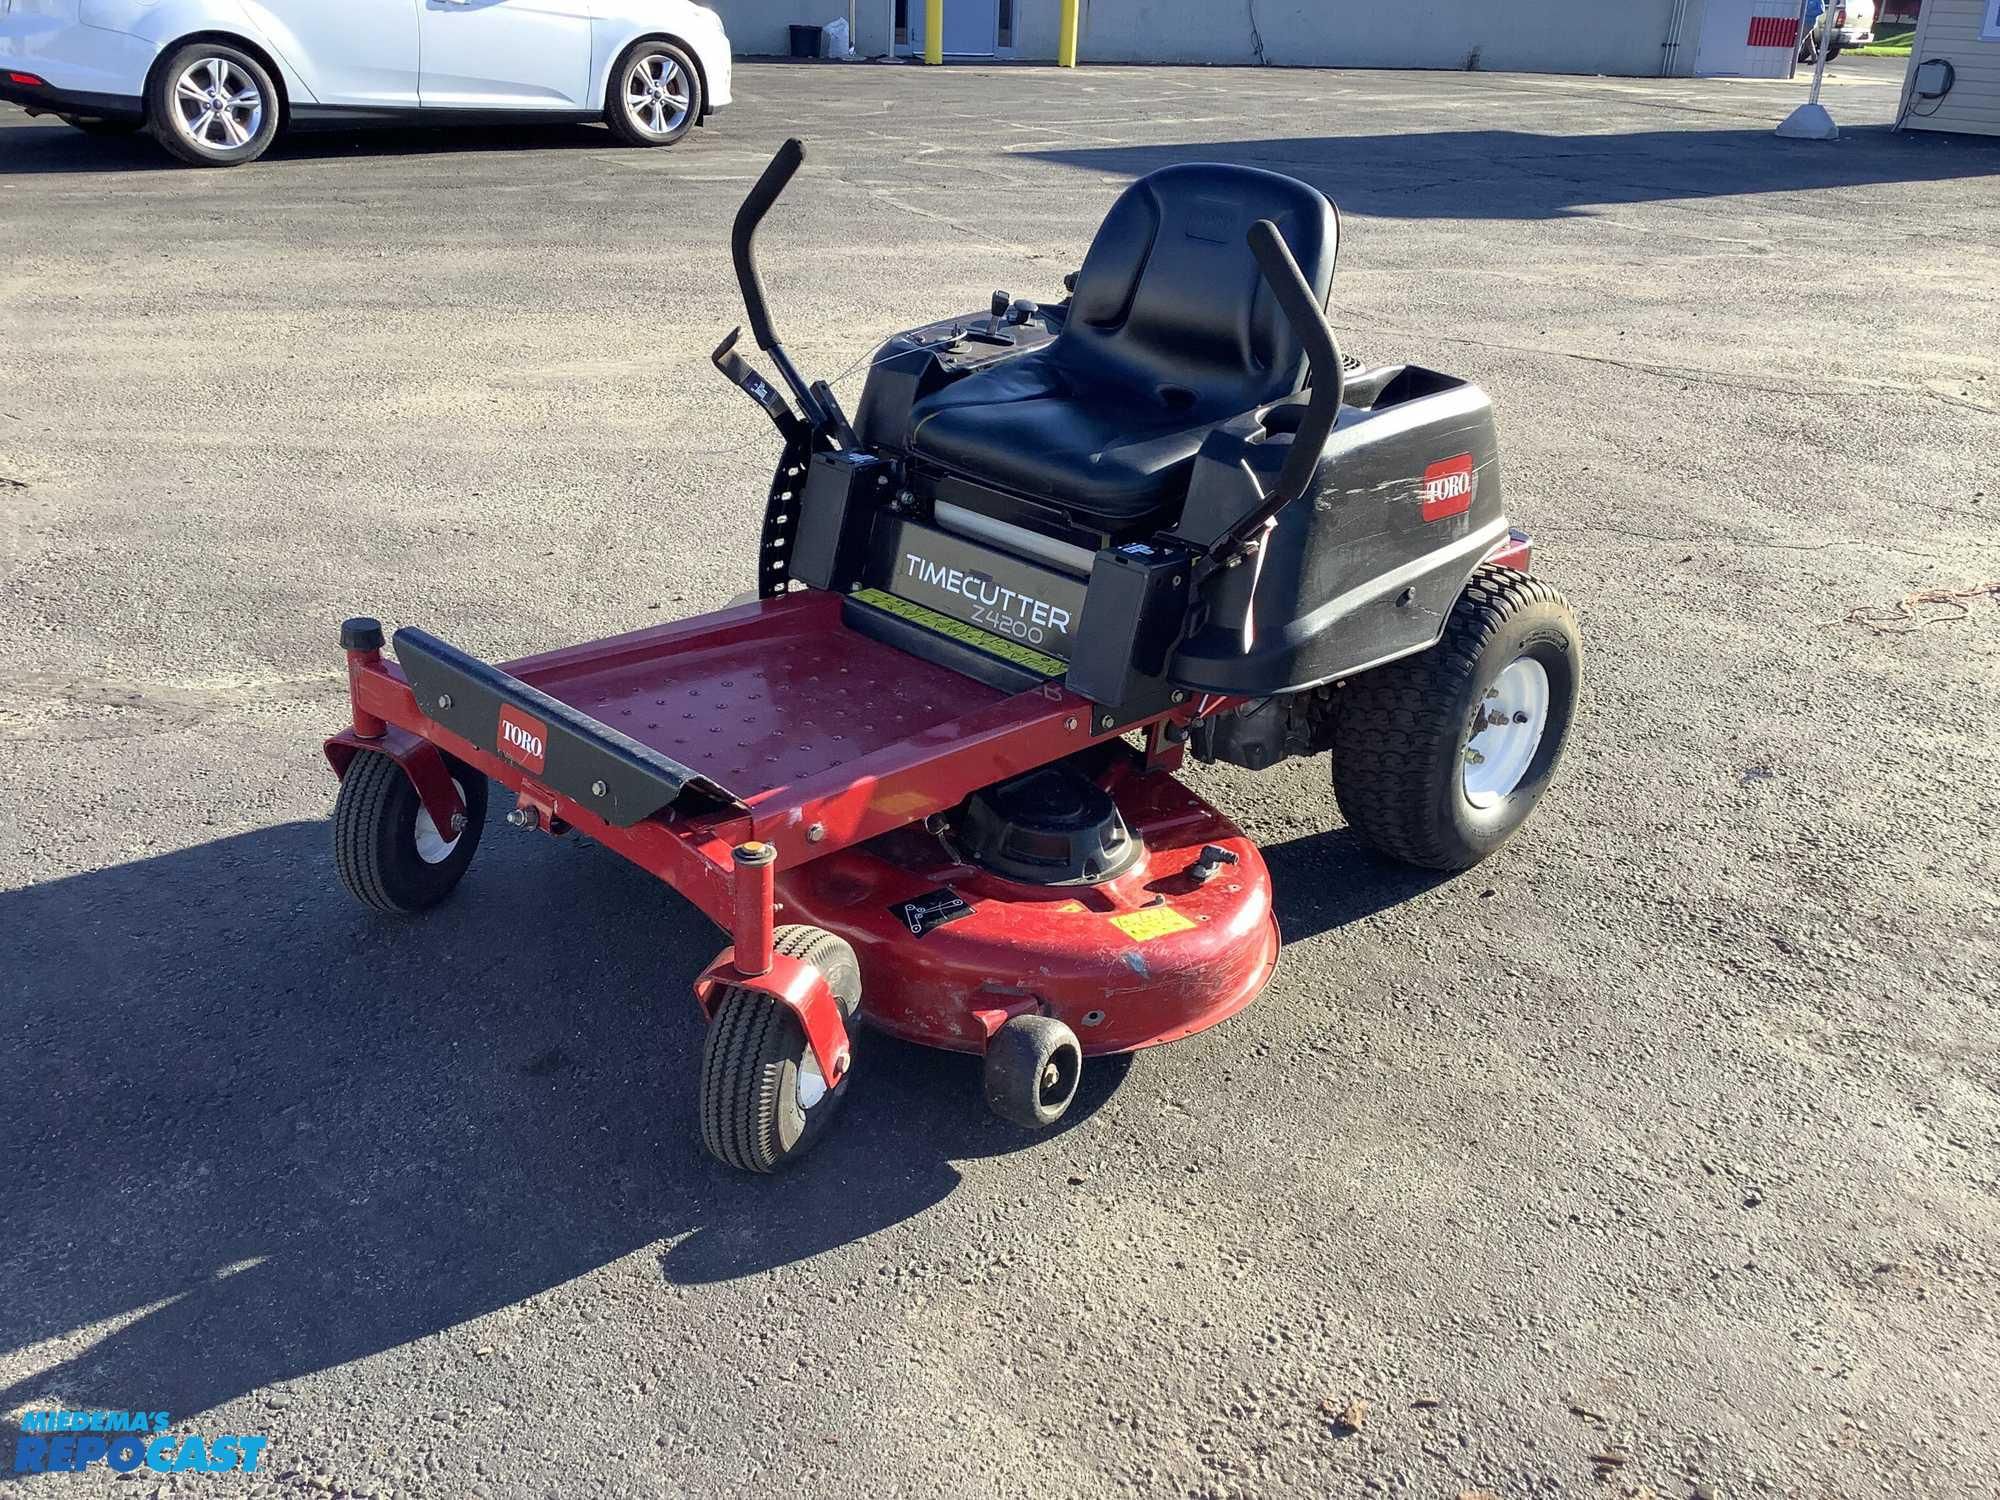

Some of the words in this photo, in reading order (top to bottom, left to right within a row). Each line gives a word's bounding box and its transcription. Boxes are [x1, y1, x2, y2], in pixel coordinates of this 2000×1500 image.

[1426, 472, 1470, 503] TORO
[906, 554, 1071, 633] TIMECUTTER
[970, 605, 1043, 644] Z4200
[502, 720, 542, 757] TORO
